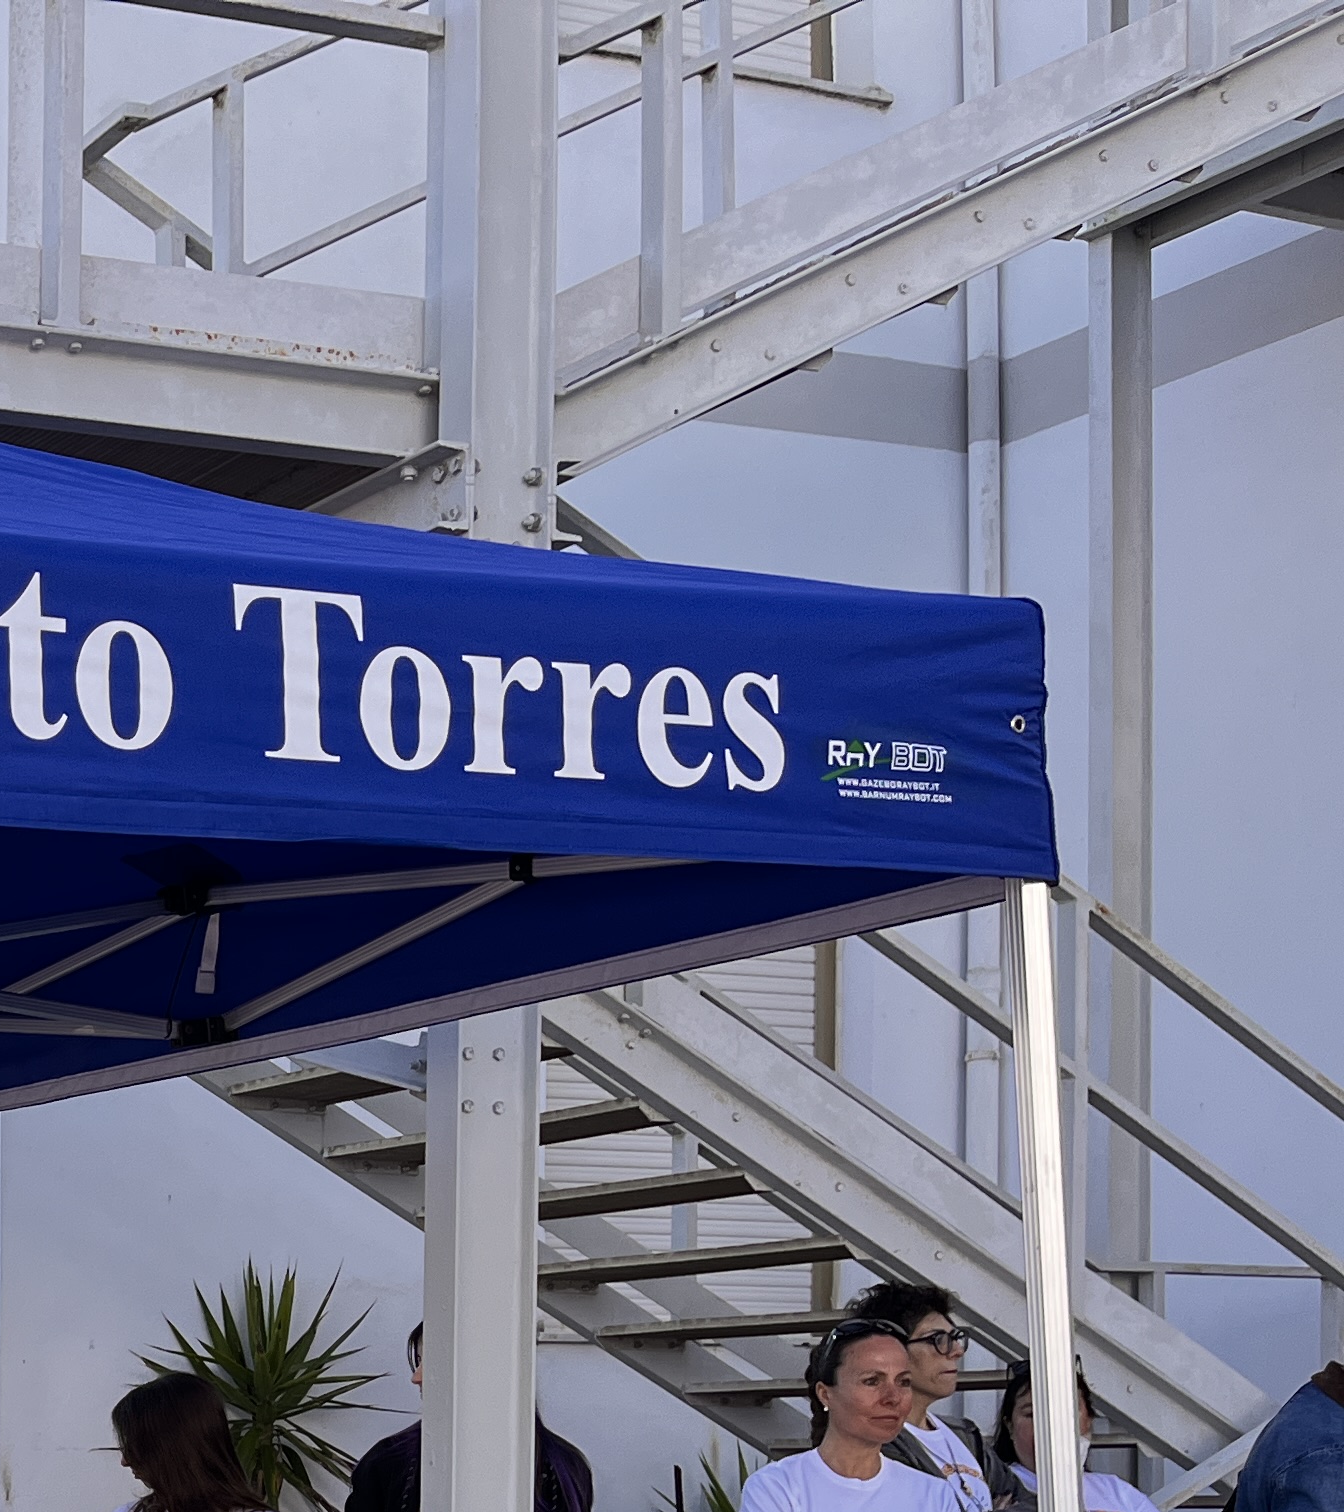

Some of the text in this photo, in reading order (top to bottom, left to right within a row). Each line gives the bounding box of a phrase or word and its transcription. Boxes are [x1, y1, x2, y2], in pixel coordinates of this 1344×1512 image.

[232, 583, 785, 792] Torres
[891, 741, 947, 772] BOT
[837, 777, 940, 791] WWW.GAZEBORAYBOT.IT
[839, 789, 952, 803] WWW.BARNUMRAYBOT.COM
